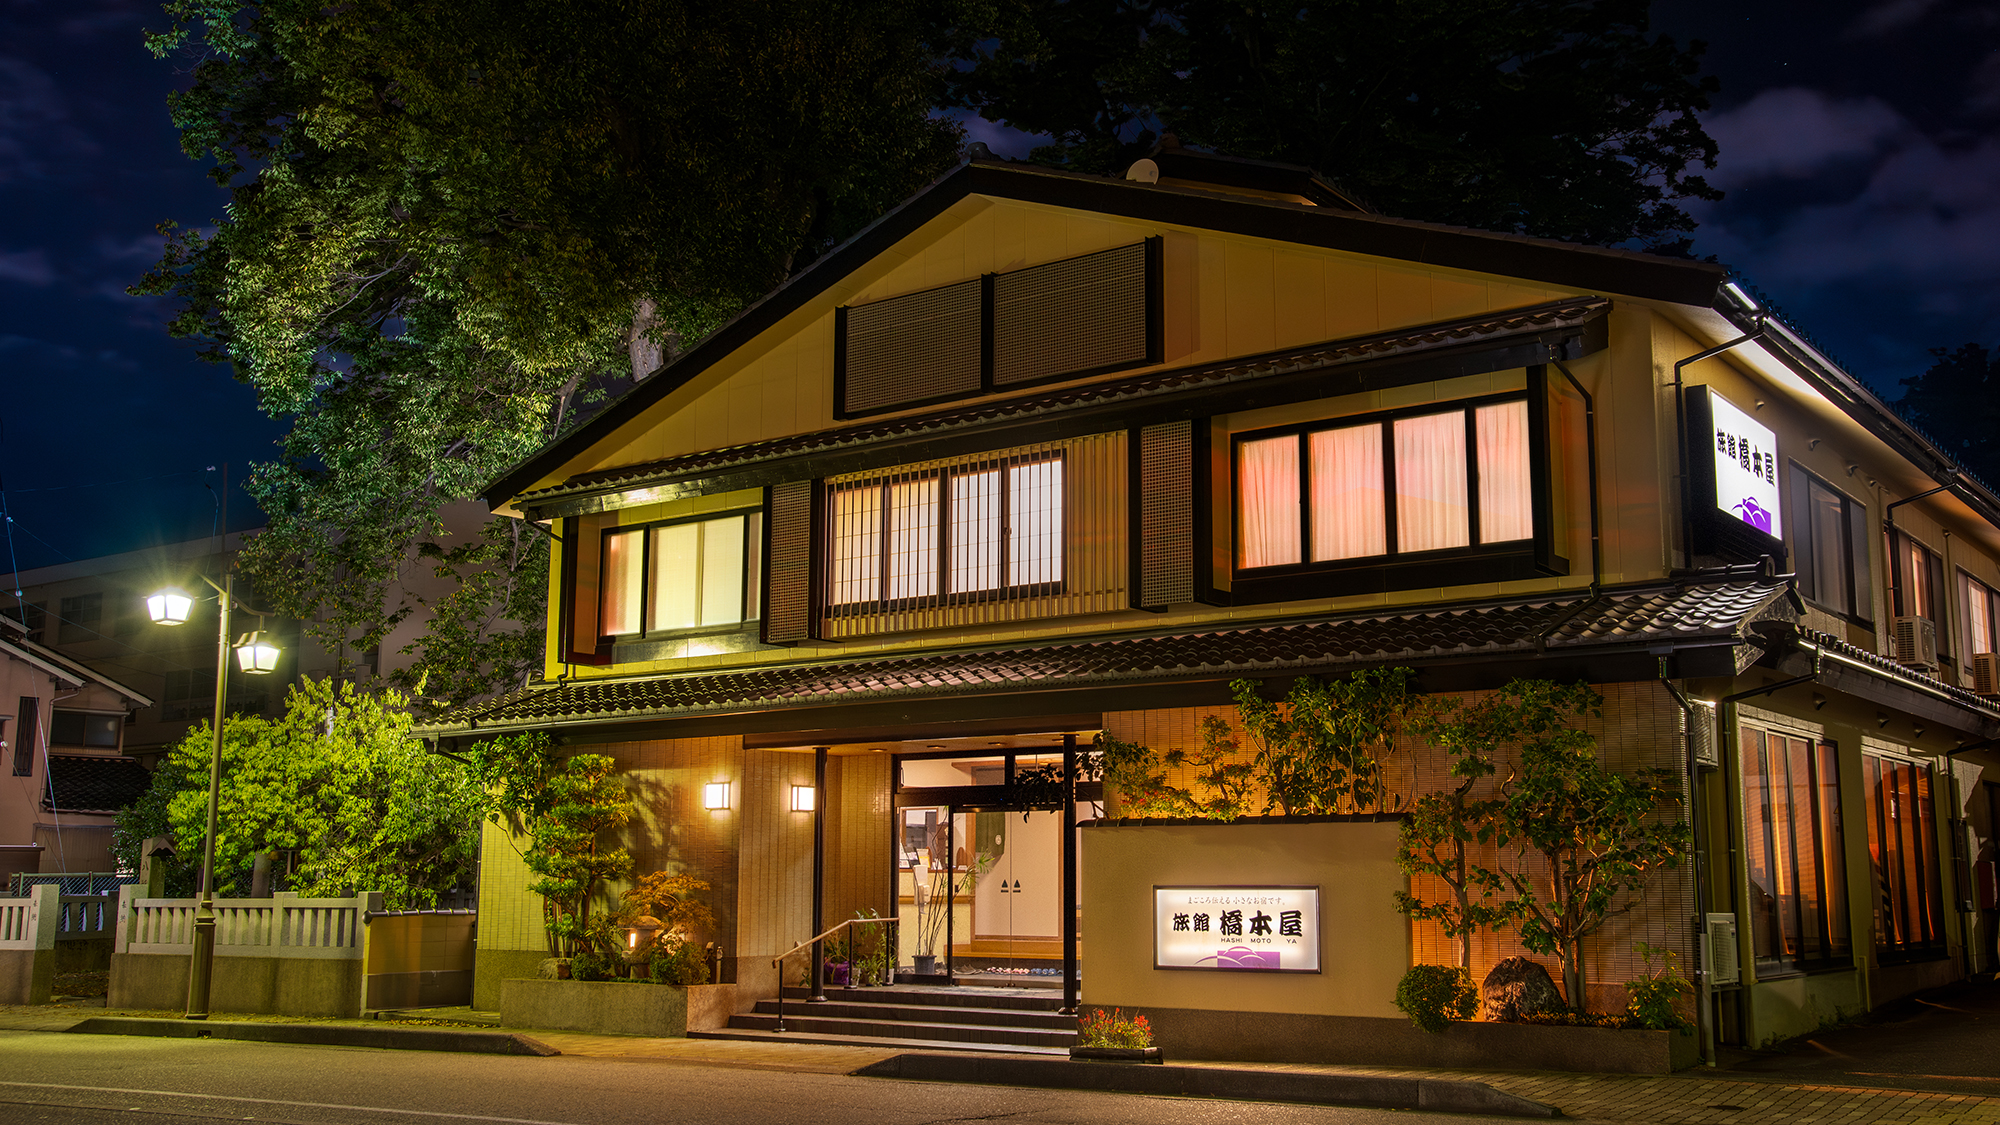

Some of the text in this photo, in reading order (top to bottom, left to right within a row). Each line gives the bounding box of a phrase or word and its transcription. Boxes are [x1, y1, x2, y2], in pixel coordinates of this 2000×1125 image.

[1717, 428, 1775, 487] 旅館 橋本屋
[1173, 909, 1303, 937] 旅館 橋本屋
